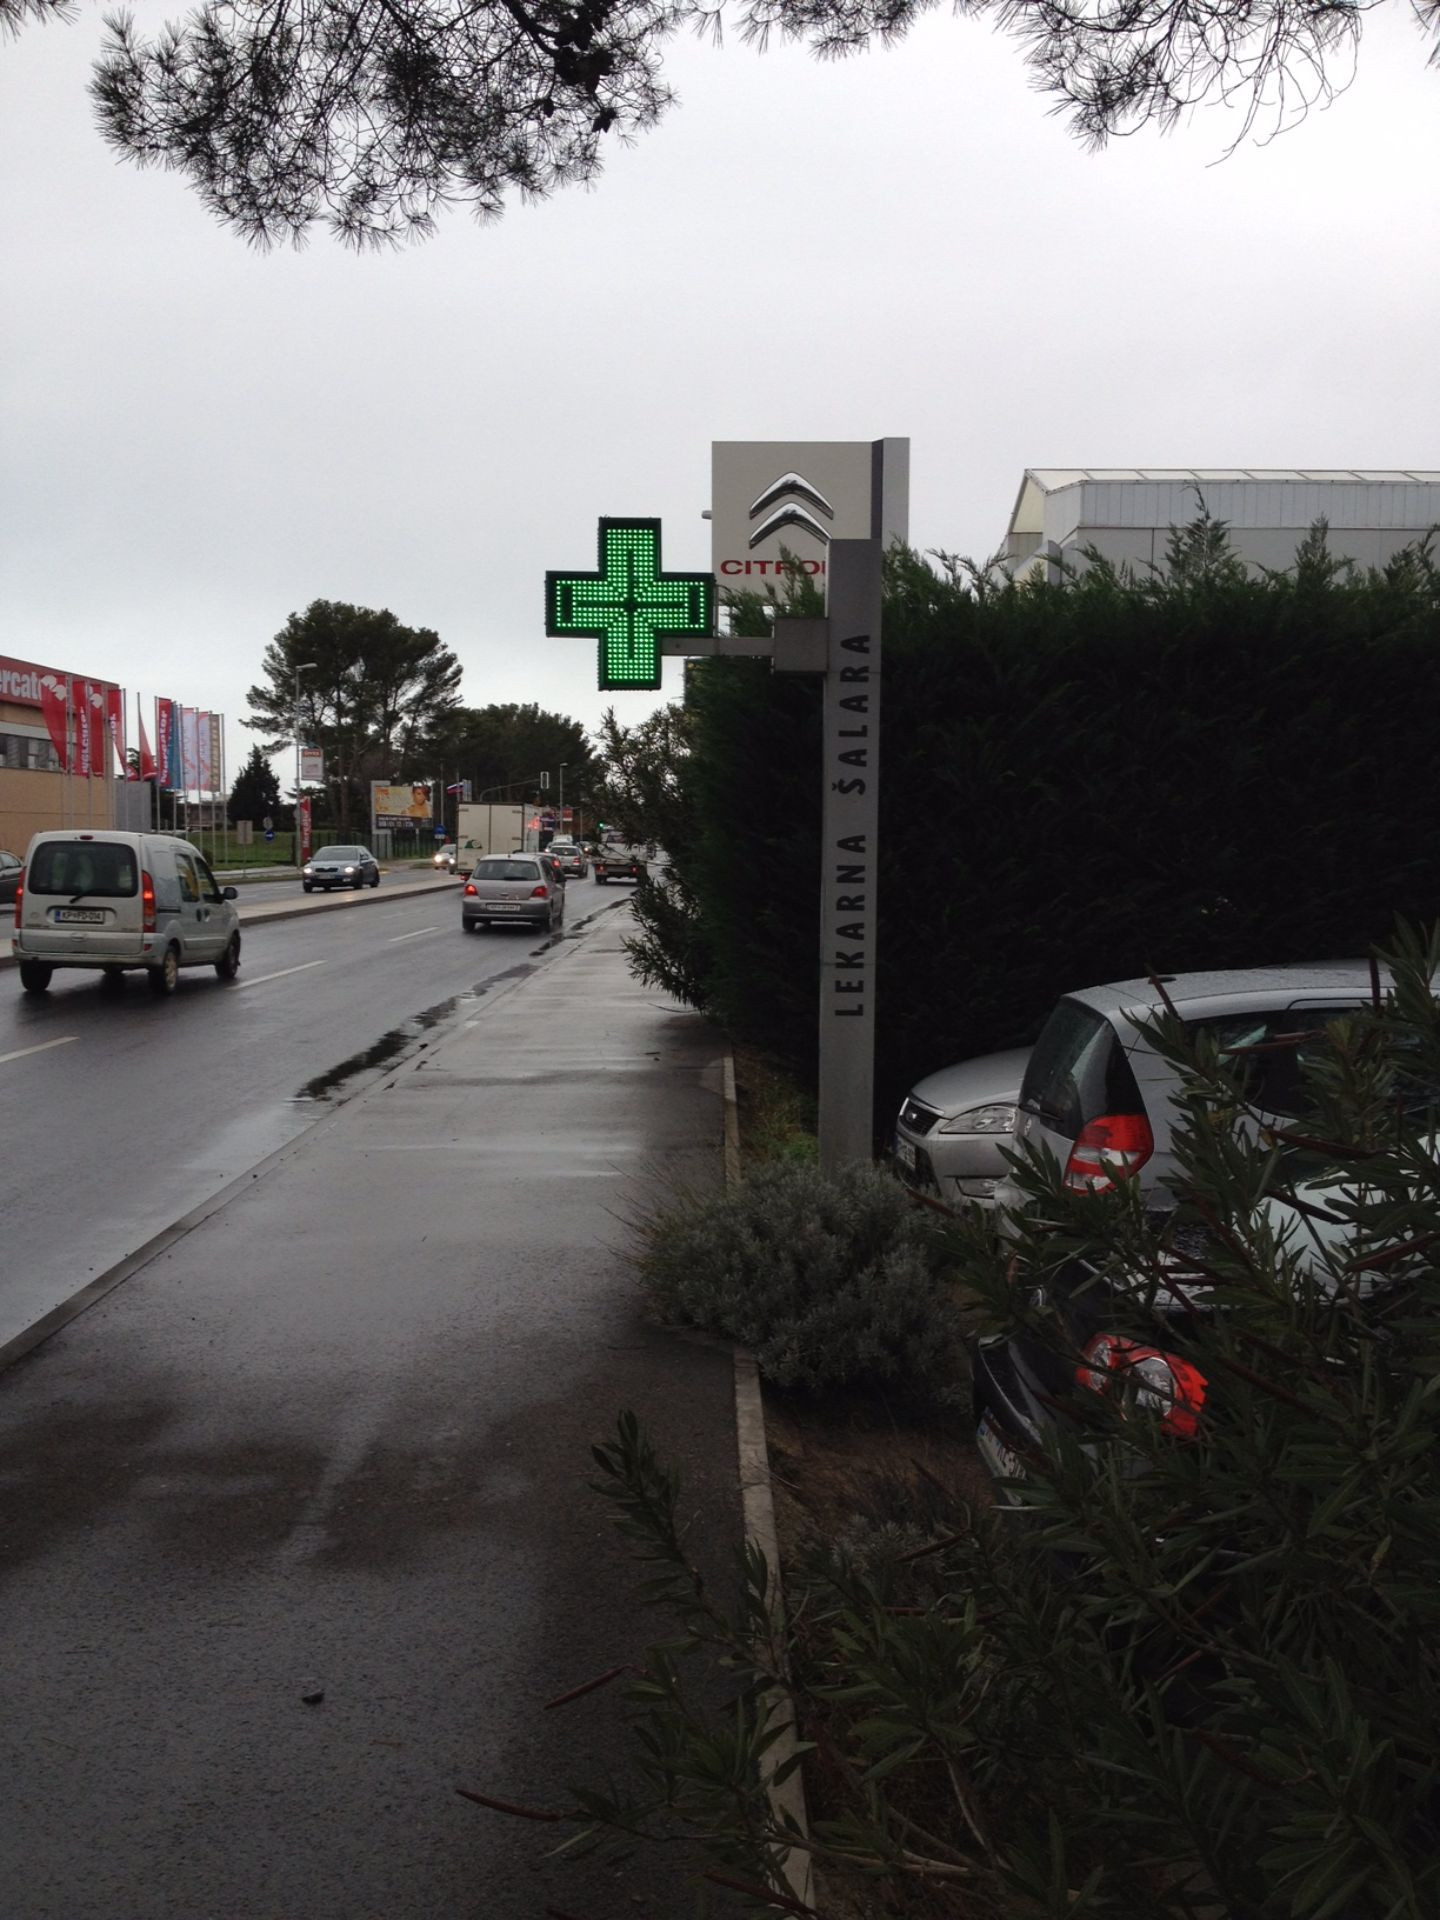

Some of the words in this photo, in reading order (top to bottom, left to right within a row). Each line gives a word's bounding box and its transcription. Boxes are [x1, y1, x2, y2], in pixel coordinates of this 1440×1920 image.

[720, 560, 826, 575] CITRO
[0, 668, 42, 701] rcat
[831, 634, 871, 796] ŠALARA
[834, 834, 867, 1017] LEKARNA
